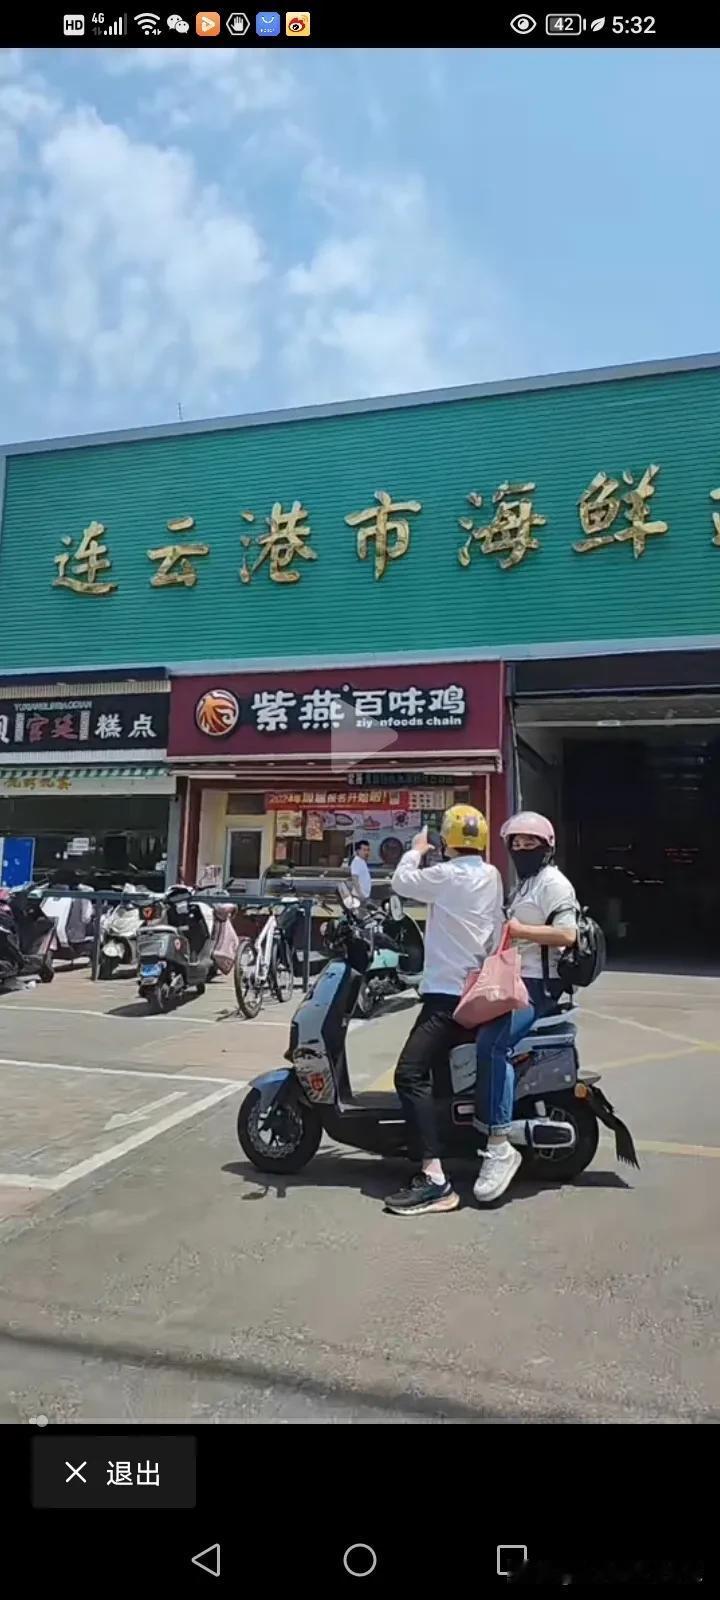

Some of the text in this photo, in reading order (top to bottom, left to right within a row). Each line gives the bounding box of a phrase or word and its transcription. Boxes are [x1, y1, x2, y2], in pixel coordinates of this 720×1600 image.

[52, 463, 720, 596] 连云港市海鲜
[425, 715, 463, 727] chain
